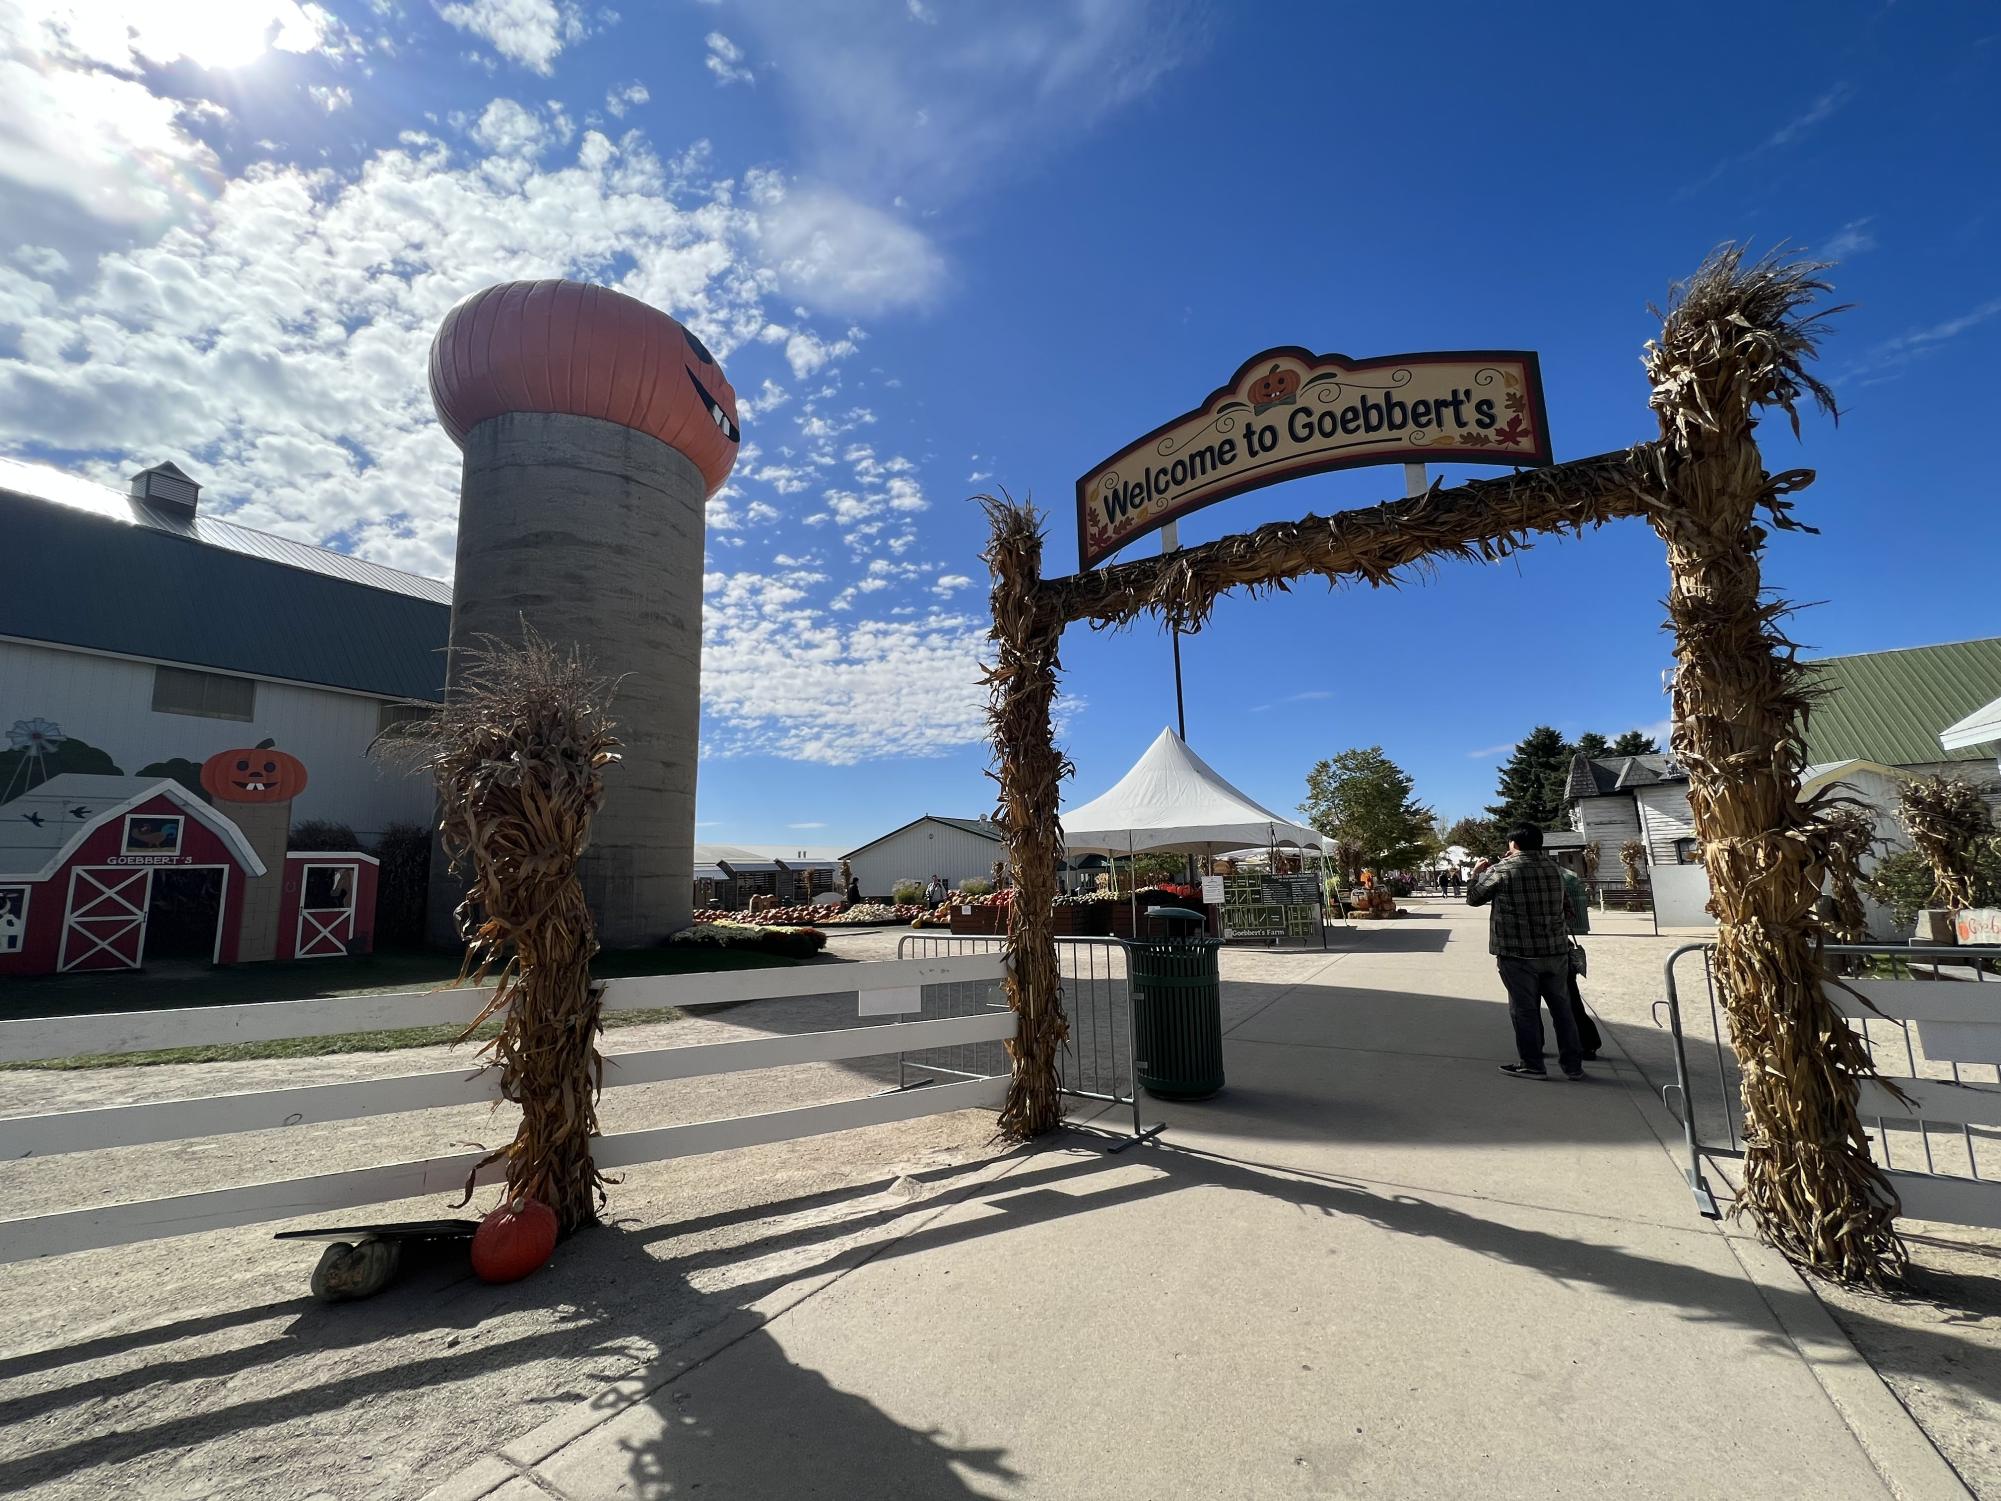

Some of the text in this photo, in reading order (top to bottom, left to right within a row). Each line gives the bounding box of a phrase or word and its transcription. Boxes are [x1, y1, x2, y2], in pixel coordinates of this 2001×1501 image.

[1102, 388, 1499, 525] Welcome to Goebbert's
[107, 856, 193, 865] GOEBBERT'S
[1266, 928, 1285, 936] Farm
